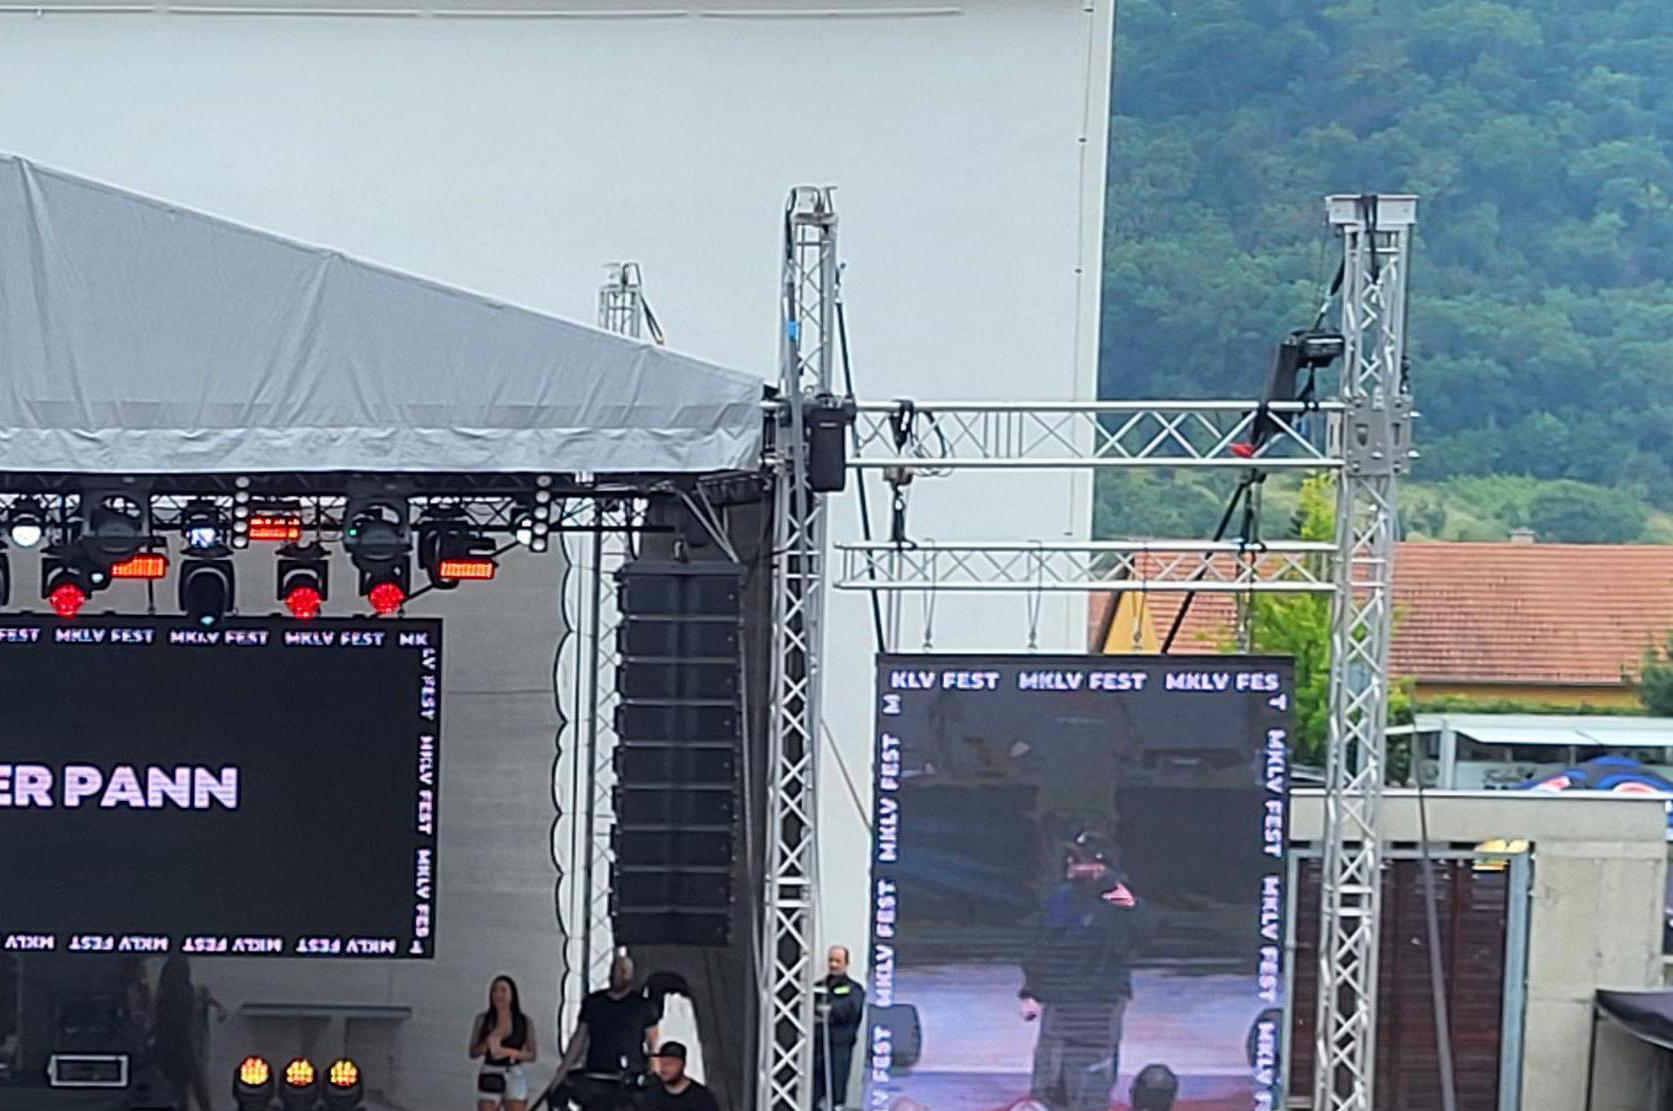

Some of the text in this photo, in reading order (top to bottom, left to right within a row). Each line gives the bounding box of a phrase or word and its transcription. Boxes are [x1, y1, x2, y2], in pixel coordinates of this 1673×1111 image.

[56, 629, 105, 642] MKLV
[111, 629, 154, 642] FEST
[170, 631, 219, 644] MKLV
[224, 631, 268, 644] FEST
[284, 632, 333, 645] MKLV
[339, 632, 384, 645] FEST
[399, 633, 428, 646] MK
[891, 671, 1279, 691] KLV FEST MKLV FEST MKLV FES
[419, 736, 434, 785] MKLV
[881, 734, 900, 790] FEST
[1267, 729, 1286, 792] MKLV
[64, 766, 238, 809] PANN
[418, 790, 433, 835] FEST
[879, 799, 898, 861] MKLV
[1265, 801, 1284, 857] FEST
[416, 850, 431, 899] MKLV
[877, 880, 896, 937] FEST
[1262, 876, 1279, 939] MKLV
[5, 935, 54, 949] MKLV
[69, 936, 113, 950] FEST
[119, 936, 168, 950] MKLV
[183, 938, 227, 952] FEST
[232, 938, 282, 952] MKLV
[296, 939, 340, 953] FEST
[346, 939, 395, 953] MKLV
[875, 945, 895, 1007] MKLV
[1260, 947, 1278, 1003] FEST
